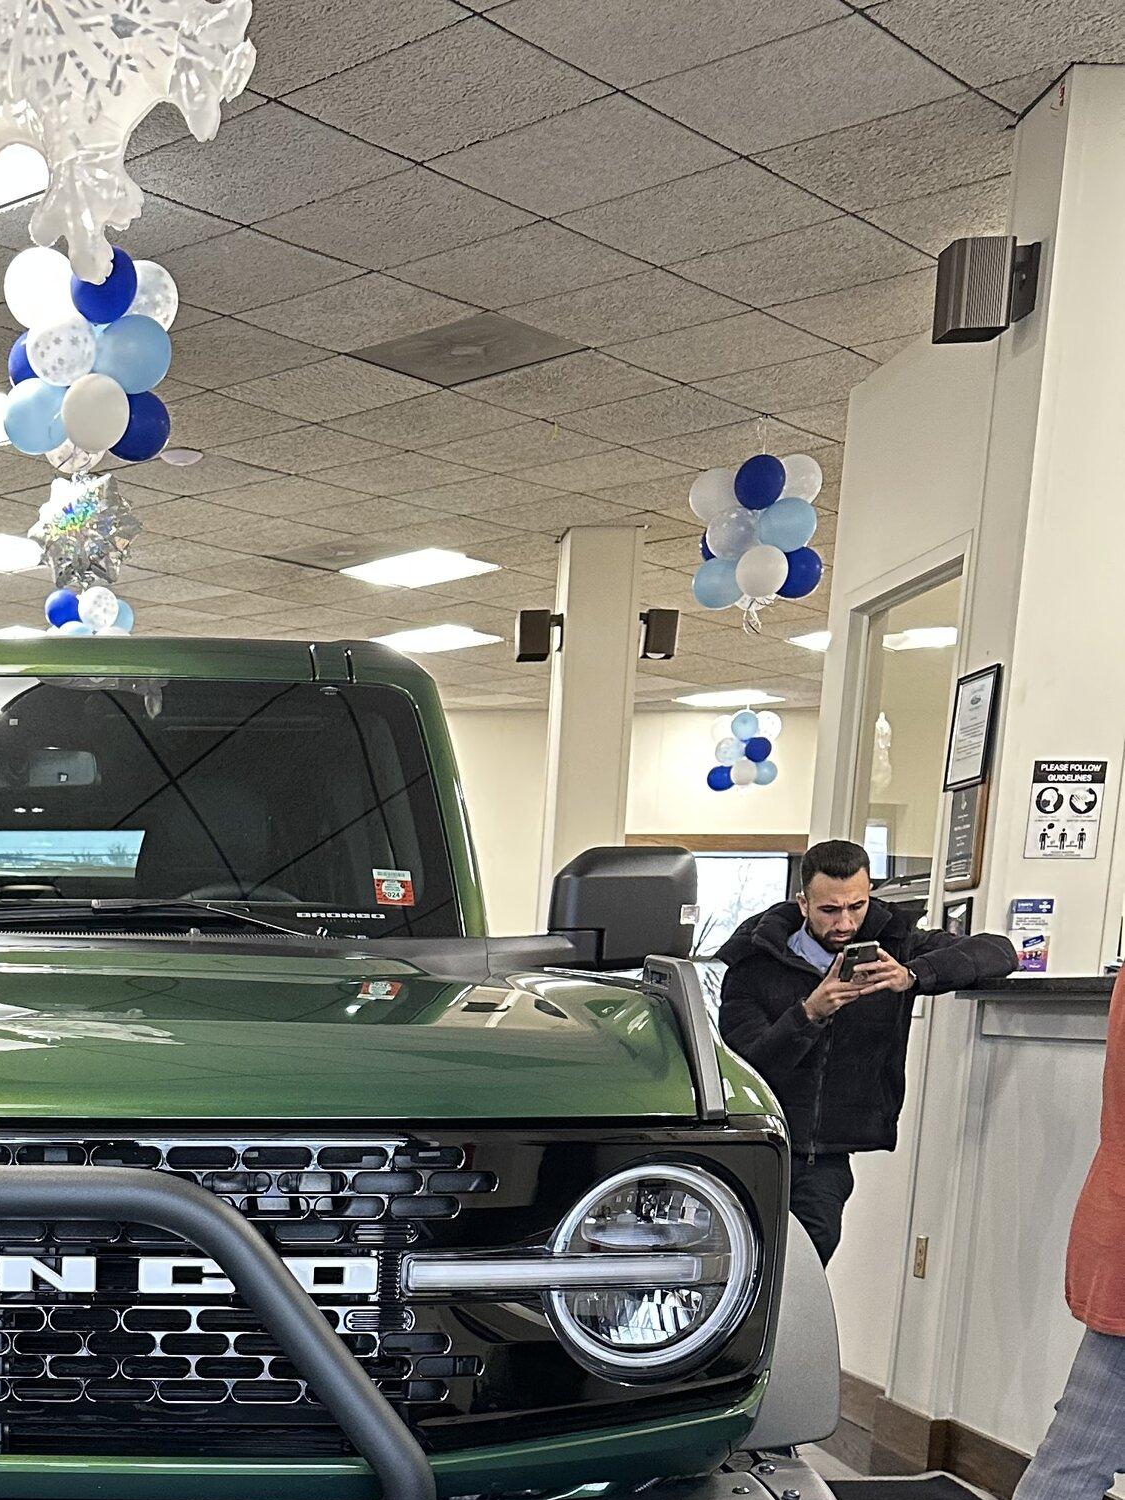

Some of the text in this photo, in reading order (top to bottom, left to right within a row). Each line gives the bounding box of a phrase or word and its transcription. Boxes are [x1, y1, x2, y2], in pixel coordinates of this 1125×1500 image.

[1040, 763, 1102, 771] PLEASE FOLLOW
[1047, 773, 1093, 782] GUIDELINES
